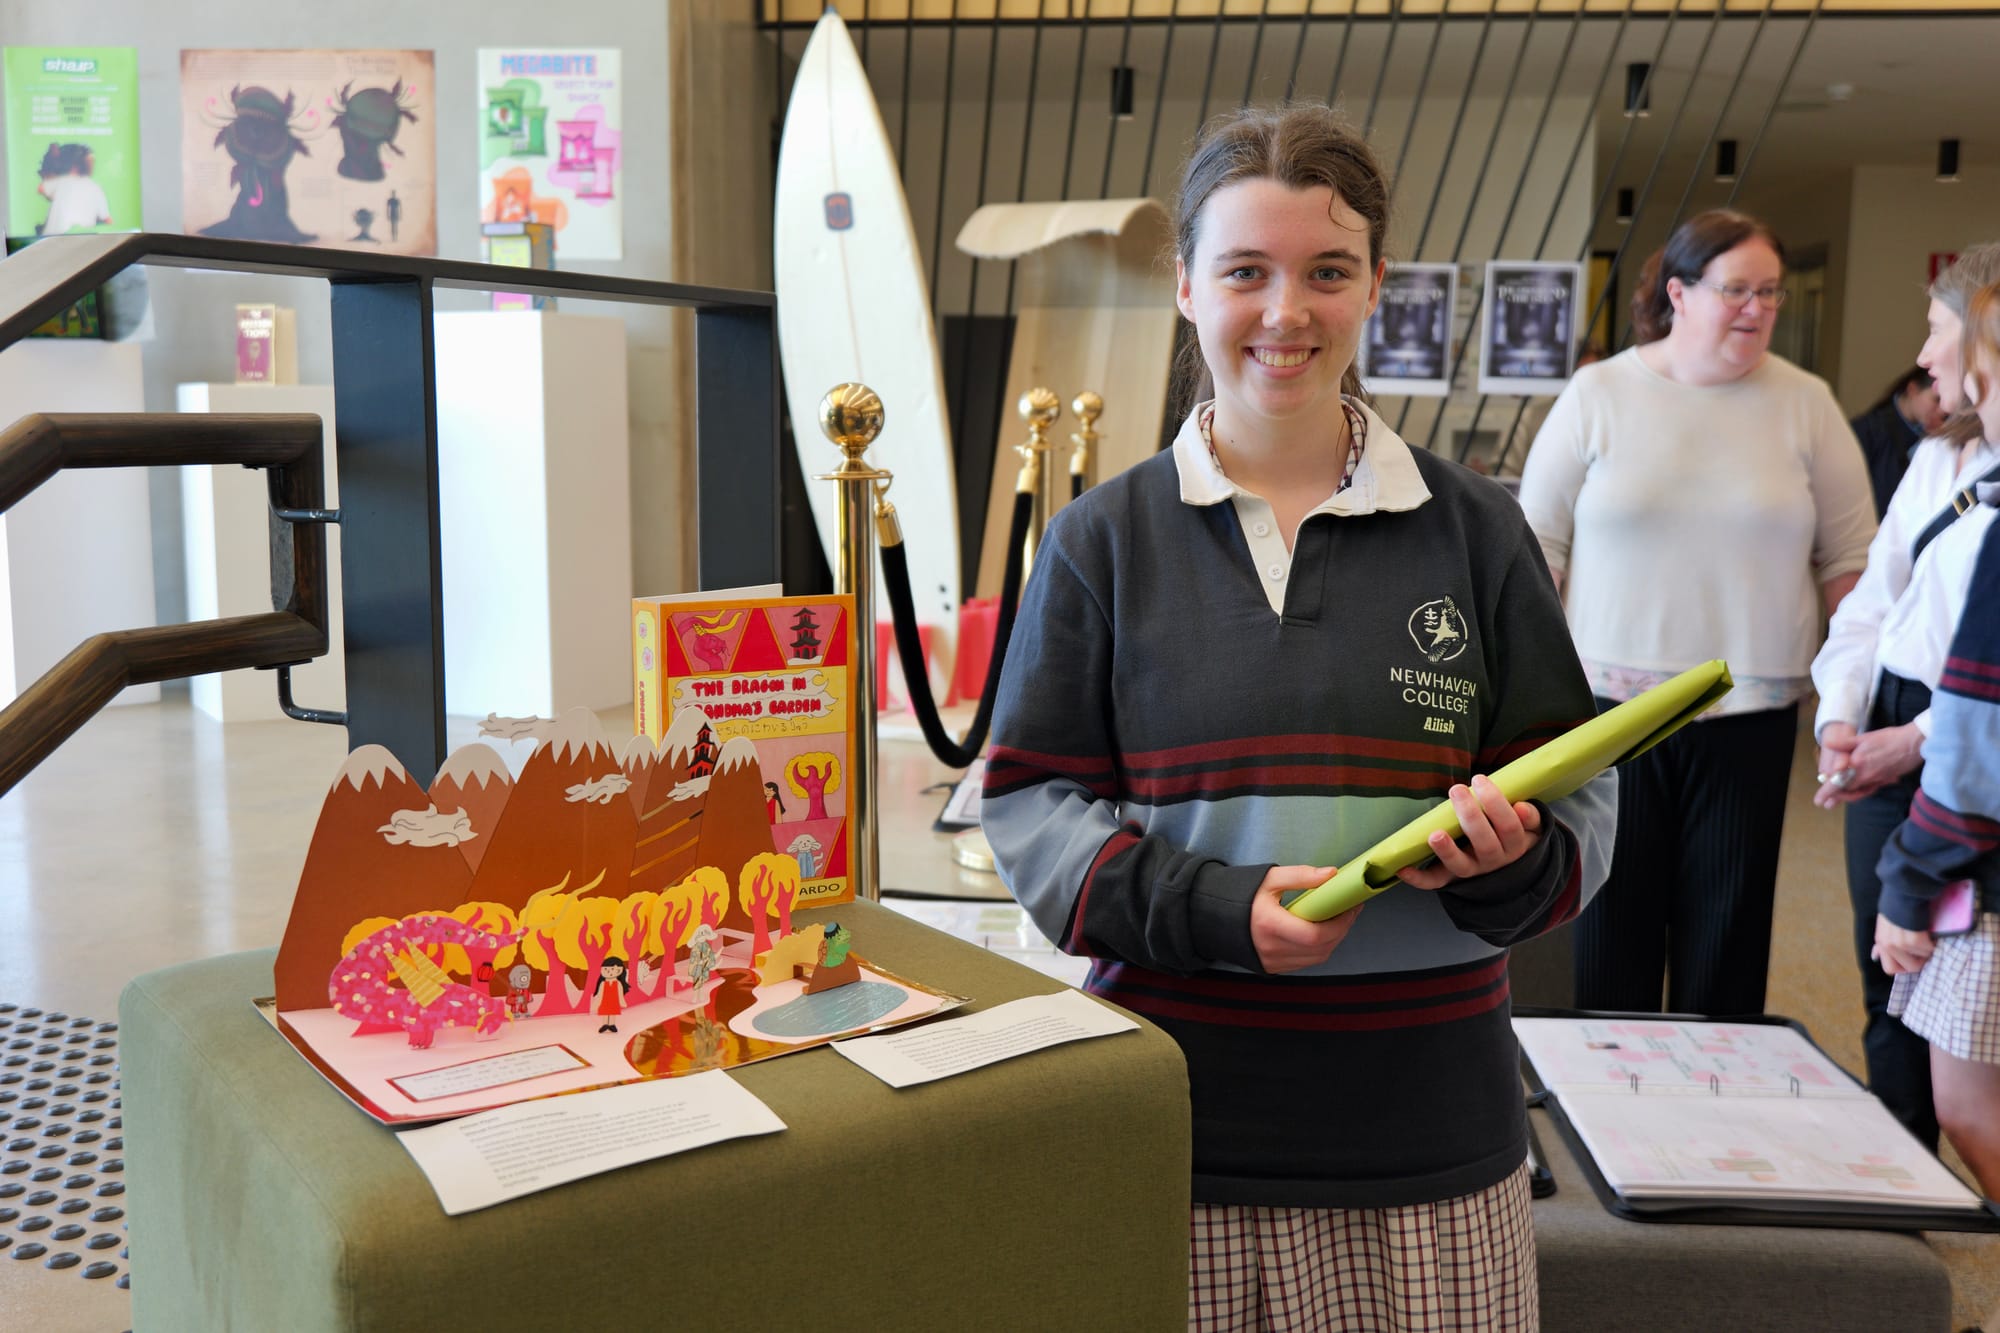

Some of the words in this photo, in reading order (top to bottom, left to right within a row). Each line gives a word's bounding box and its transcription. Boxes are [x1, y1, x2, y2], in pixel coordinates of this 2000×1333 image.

[500, 55, 597, 76] MEGABITE
[691, 680, 724, 697] THE
[731, 678, 785, 694] DRAGON
[792, 676, 807, 690] IN
[1390, 667, 1477, 697] NEWHAVEN
[685, 700, 763, 720] ANDMA'S
[768, 698, 821, 716] GARDEN
[1402, 688, 1469, 714] COLLEGE
[1423, 716, 1456, 734] Ailish
